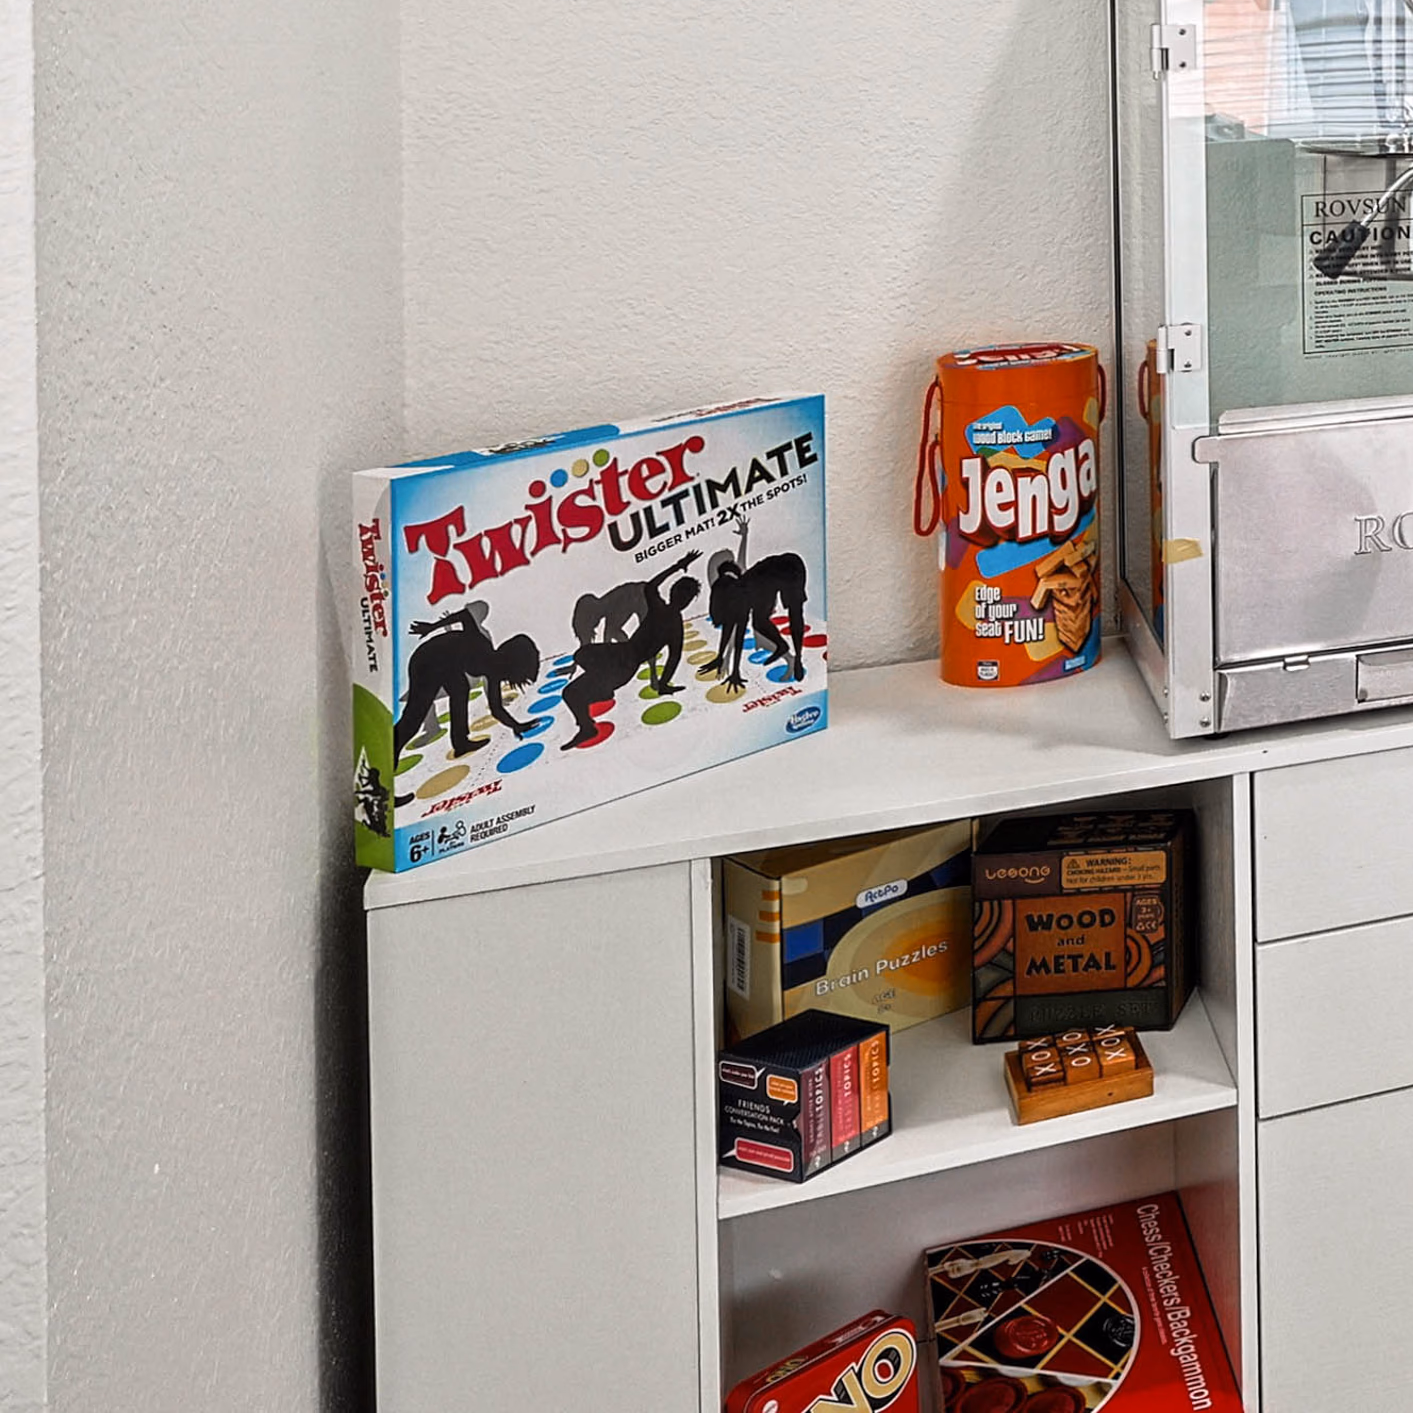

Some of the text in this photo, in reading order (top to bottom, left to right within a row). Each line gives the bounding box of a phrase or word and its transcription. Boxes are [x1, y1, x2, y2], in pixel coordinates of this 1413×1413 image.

[1314, 195, 1406, 218] ROVSUN
[1309, 224, 1411, 245] CAUION
[607, 432, 818, 552] ULTIMATE
[958, 438, 1097, 539] Jenga
[405, 436, 705, 605] Twister
[634, 473, 808, 563] BIGGER MAT! 2X THE SPOTS!
[358, 518, 388, 637] Twister
[975, 584, 1000, 604] Edge
[975, 602, 1017, 622] of your
[360, 597, 378, 673] ULTIMATE
[975, 617, 1044, 644] seat FUN!
[470, 805, 536, 833] ADULT ASSEMBLY
[470, 824, 508, 843] REQUIRED
[410, 844, 430, 864] 6+
[1025, 908, 1116, 932] WOOD
[1057, 934, 1086, 946] and
[815, 940, 948, 997] Brain Puzzles
[1026, 951, 1116, 977] METAL
[738, 1099, 770, 1114] FRIENDS
[1136, 1203, 1213, 1411] Chess/Checkers/Backgammon
